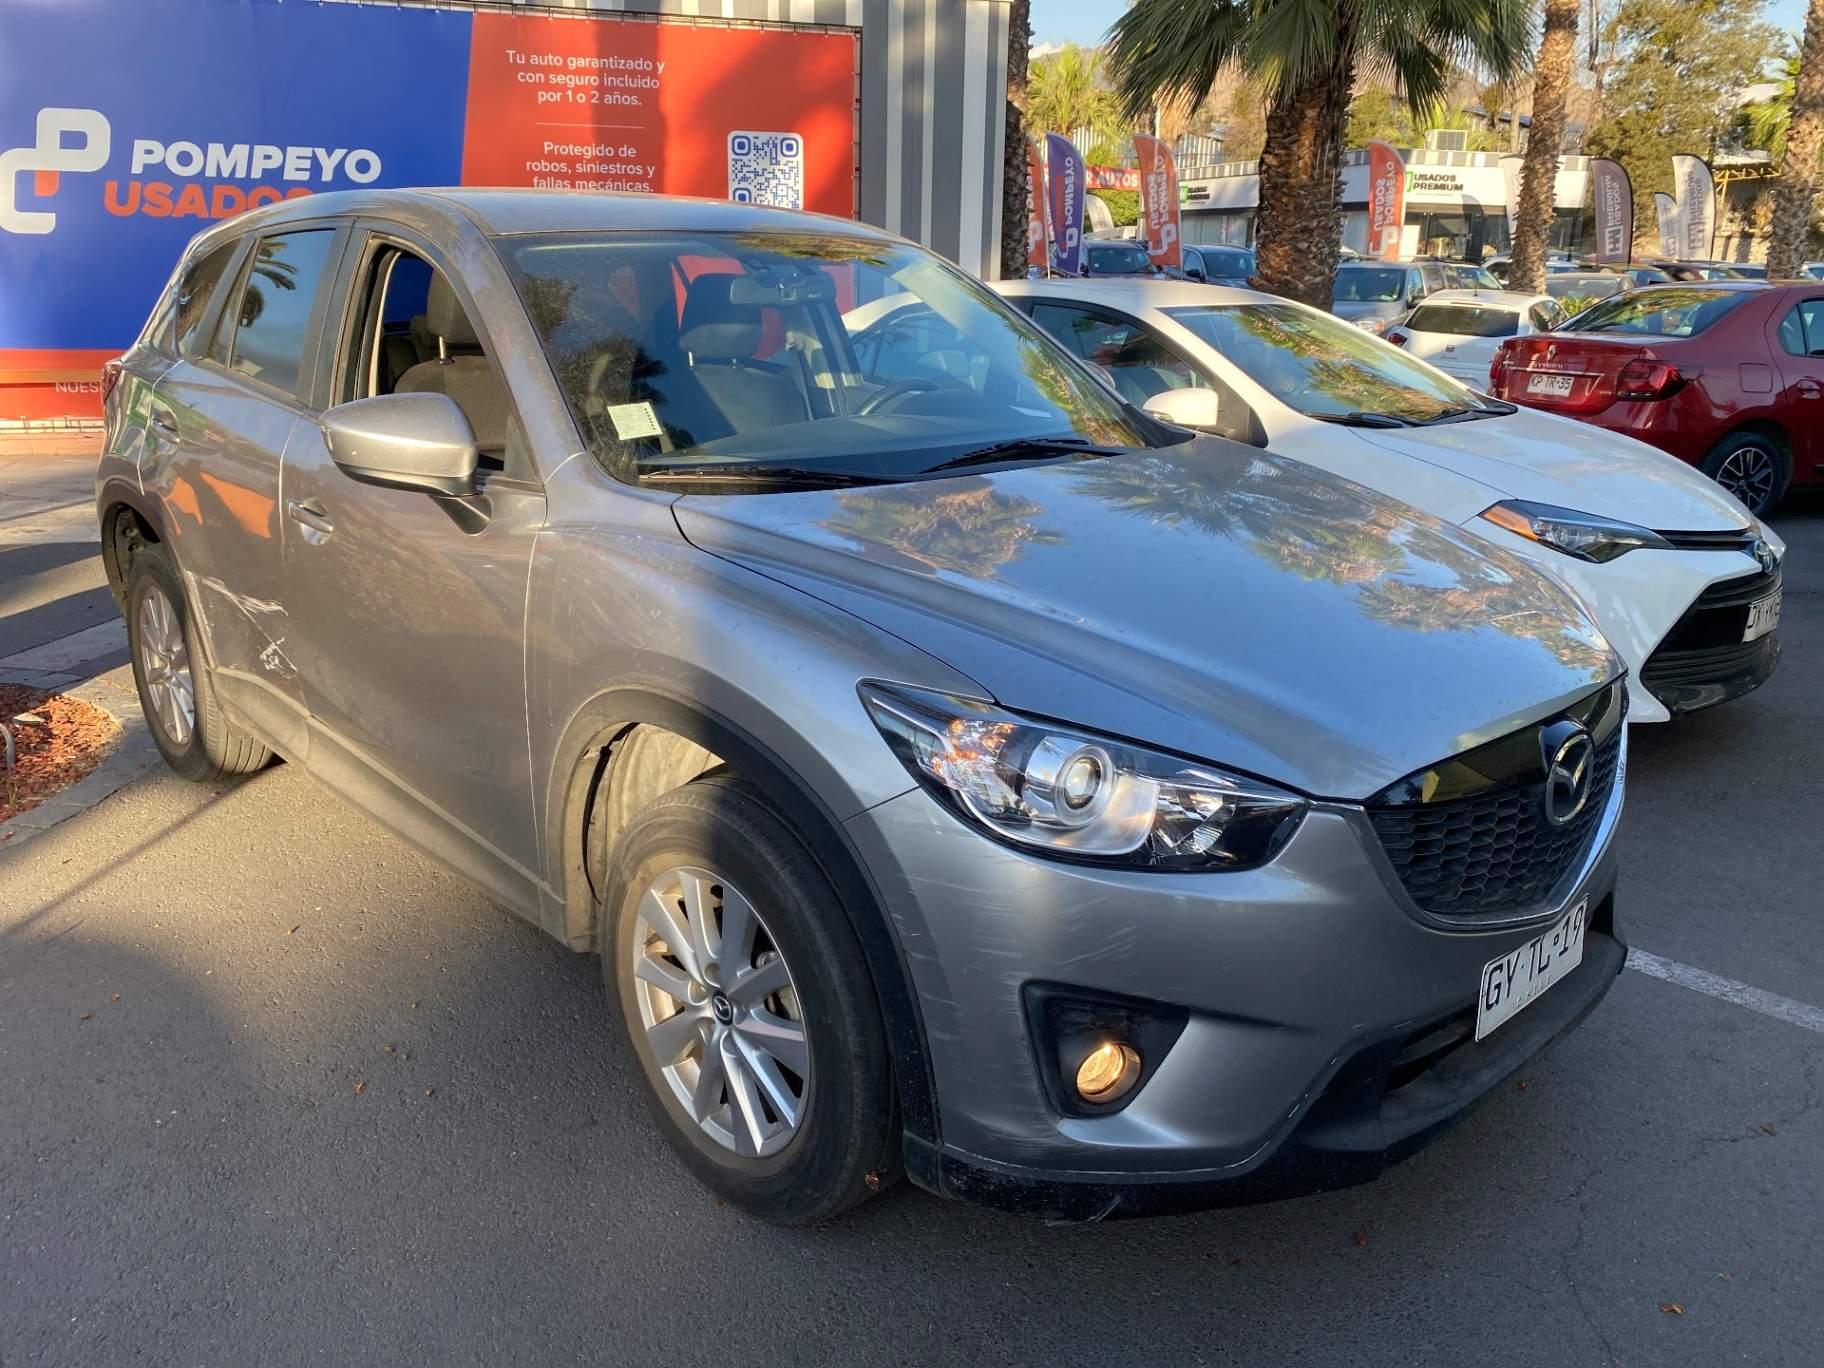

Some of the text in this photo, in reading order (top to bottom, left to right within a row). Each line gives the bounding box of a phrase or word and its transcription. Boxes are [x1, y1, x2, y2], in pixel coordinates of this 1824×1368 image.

[506, 50, 665, 74] Tu auto garantizado y
[517, 71, 660, 88] con seguro incluido
[537, 90, 642, 106] por 1 o 2 años.
[543, 141, 637, 159] Protegido de
[130, 139, 382, 184] POMPEYO
[526, 160, 655, 178] robos, siniestros y
[532, 176, 655, 193] fallas mecánicas.
[1097, 171, 1139, 188] AUTOS
[1414, 173, 1457, 182] USADOS
[1413, 182, 1464, 191] PREMIUM
[103, 180, 316, 221] USADO
[55, 381, 100, 393] NUES
